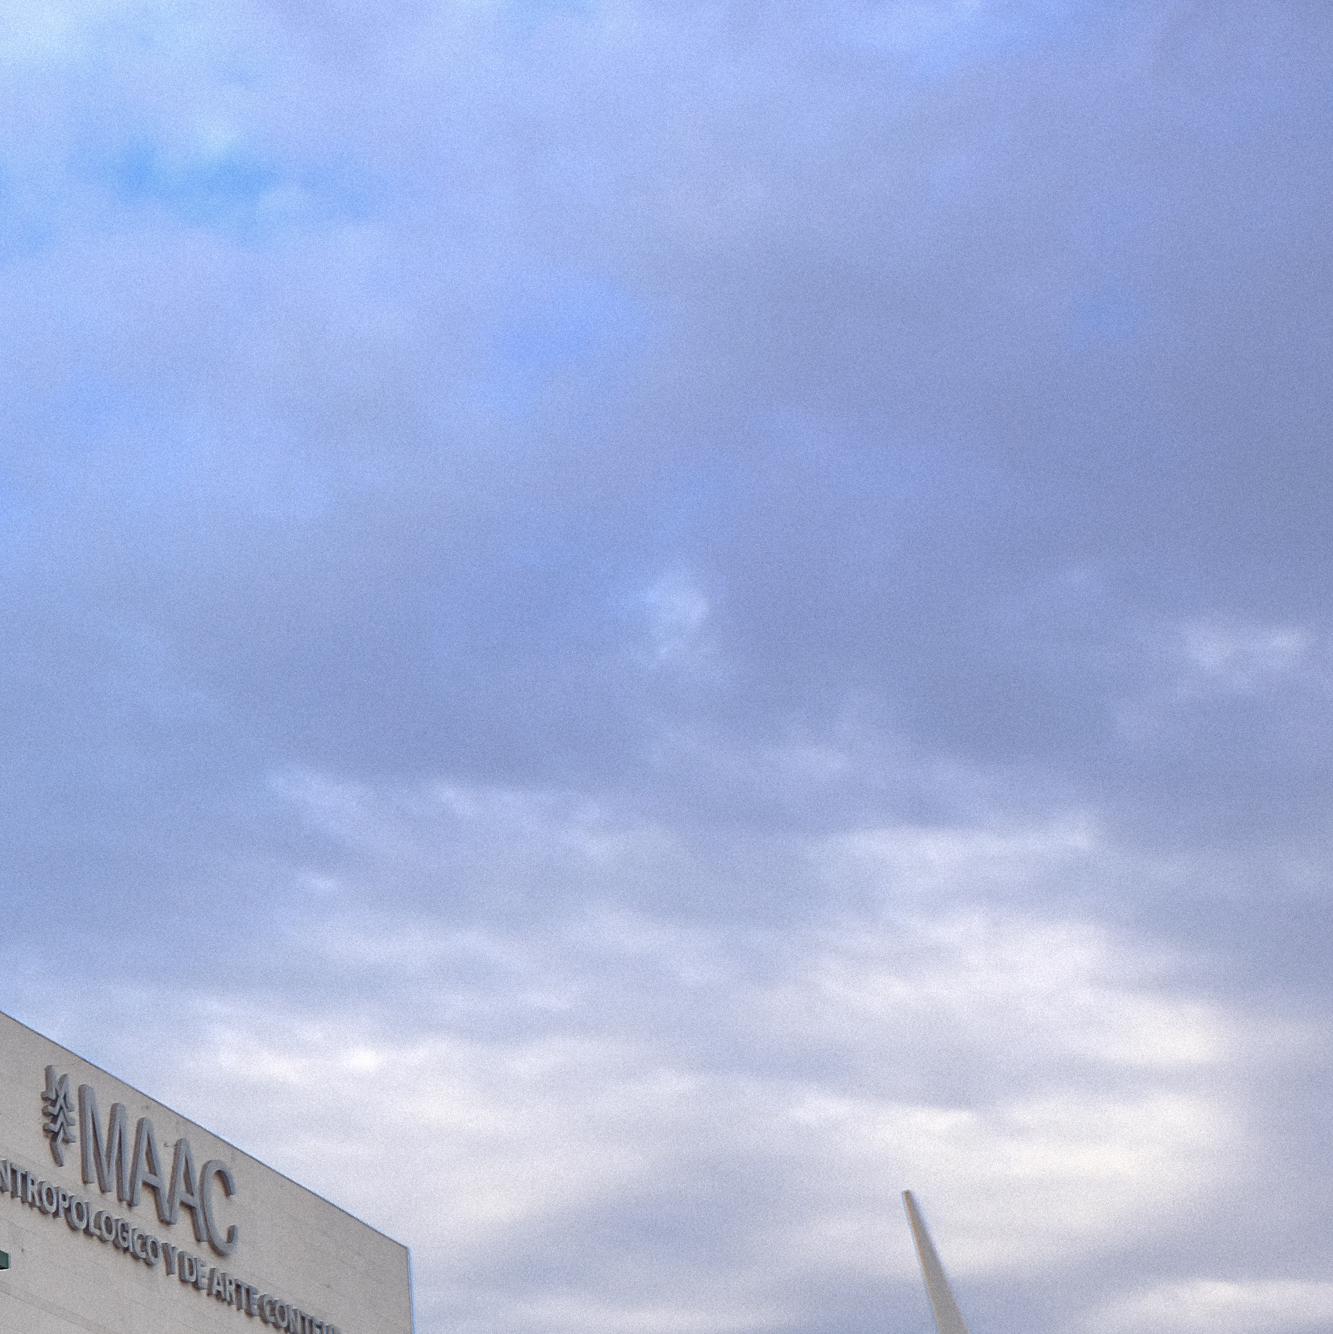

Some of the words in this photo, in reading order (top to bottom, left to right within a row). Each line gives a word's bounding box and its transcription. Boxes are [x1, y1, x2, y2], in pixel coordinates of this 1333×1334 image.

[78, 1084, 238, 1257] MAAC
[161, 1243, 178, 1276] Y
[177, 1251, 208, 1290] DE
[206, 1268, 259, 1318] ARTE
